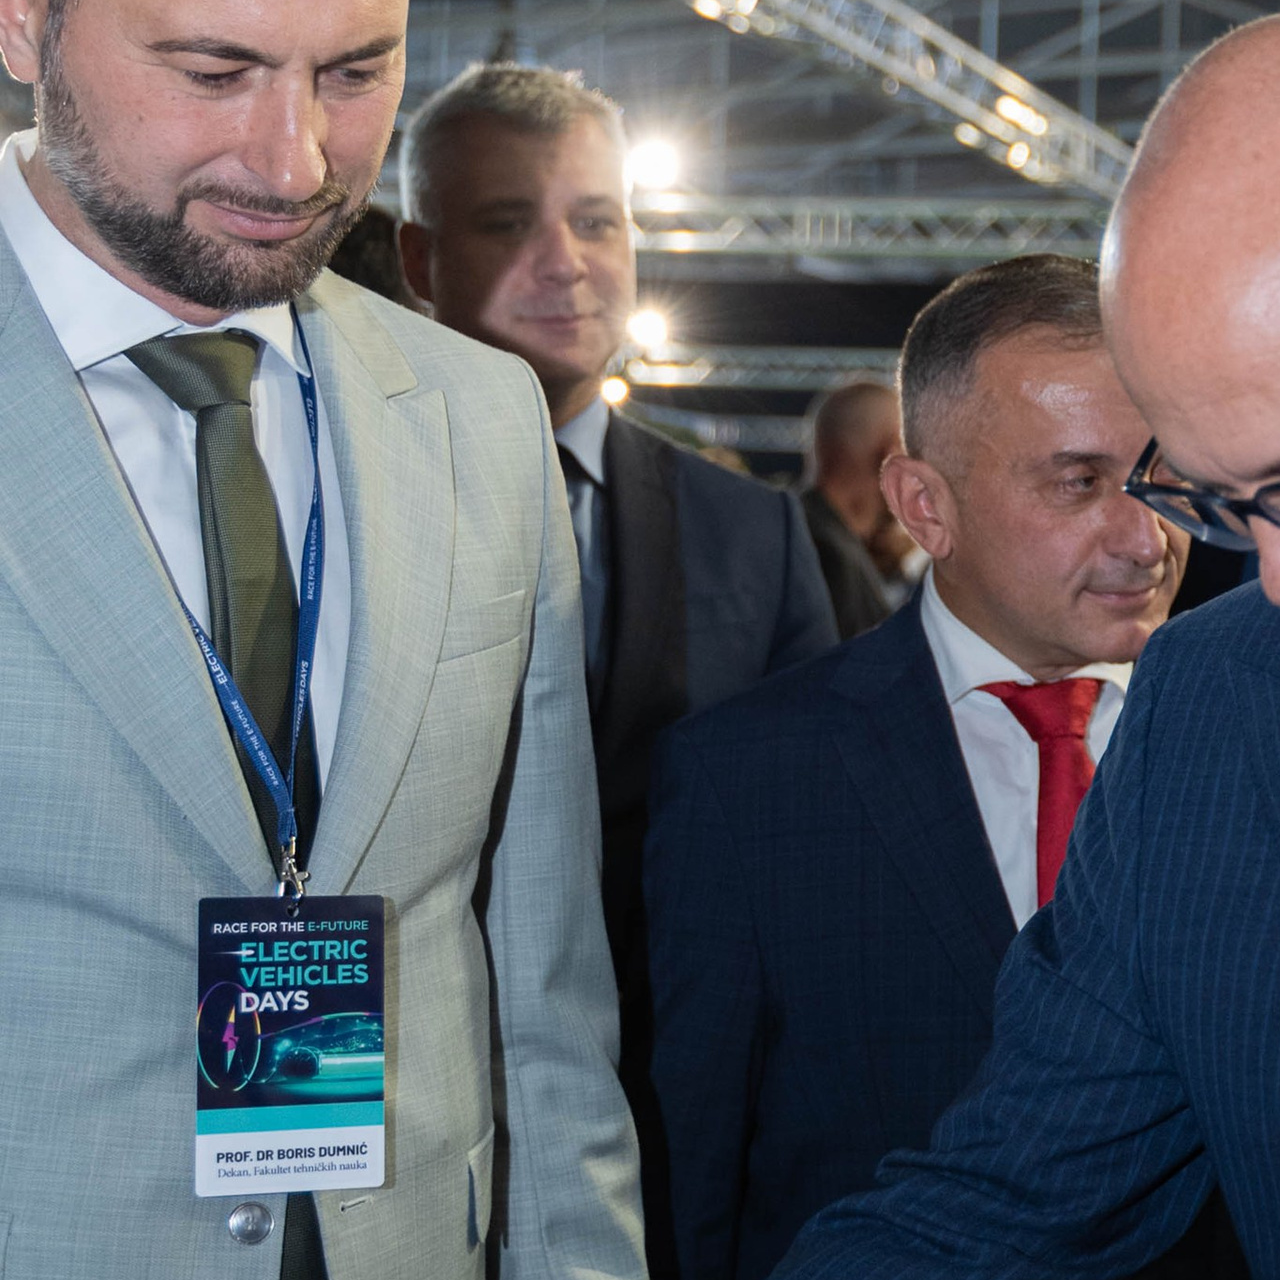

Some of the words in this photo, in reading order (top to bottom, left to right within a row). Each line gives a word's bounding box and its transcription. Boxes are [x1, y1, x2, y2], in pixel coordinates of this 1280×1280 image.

[308, 566, 316, 579] FOR
[307, 581, 315, 599] RACE
[199, 635, 228, 684] ELECTRIC
[300, 660, 309, 688] DAYS
[231, 700, 254, 735] E-FUTURE
[250, 734, 261, 750] THE
[257, 750, 269, 766] FOR
[265, 765, 279, 786] RACE
[213, 922, 248, 934] RACE
[251, 922, 277, 933] FOR
[280, 921, 305, 932] THE
[308, 920, 369, 931] E-FUTURE
[240, 940, 367, 962] ELECTRIC
[240, 965, 368, 987] VEHICLES
[240, 991, 309, 1012] DAYS
[216, 1150, 253, 1163] PROF.
[256, 1148, 274, 1161] DR
[277, 1146, 316, 1160] BORIS
[319, 1142, 368, 1157] DUMNIĆ
[217, 1167, 252, 1179] Dekan,
[253, 1164, 292, 1177] Fakultet
[293, 1162, 337, 1175] tehničkih
[339, 1161, 368, 1172] nauka
